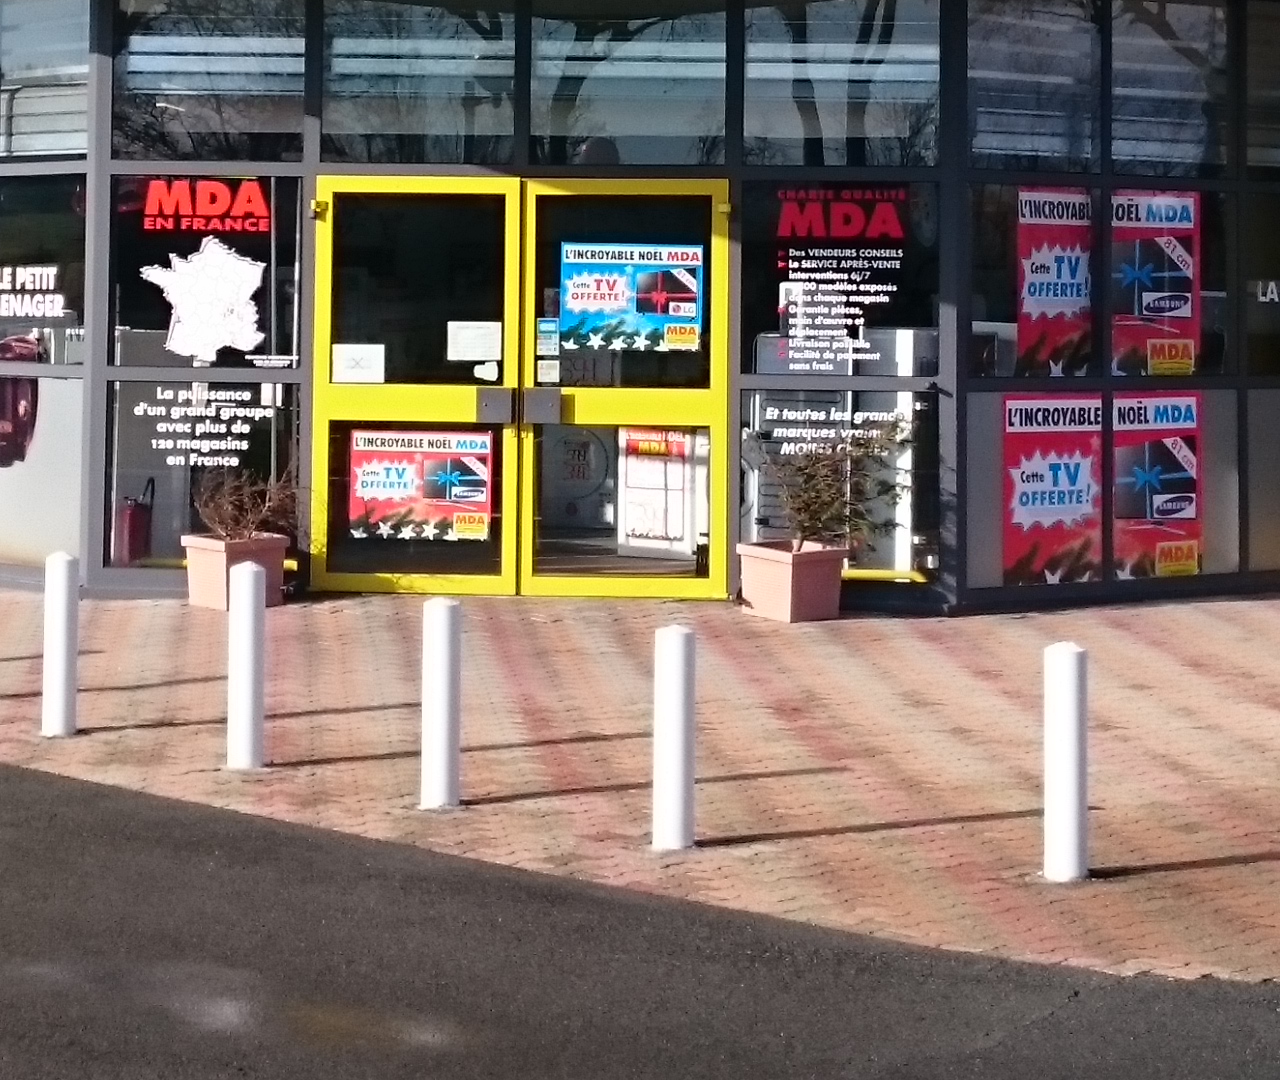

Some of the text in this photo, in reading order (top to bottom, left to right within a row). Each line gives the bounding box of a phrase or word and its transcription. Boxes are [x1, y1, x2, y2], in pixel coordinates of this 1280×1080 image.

[143, 179, 270, 217] MDA
[1112, 198, 1142, 222] OËL
[1145, 203, 1193, 223] MDA
[143, 218, 271, 233] EN FRANCE
[776, 201, 904, 238] MDA
[565, 248, 701, 262] L'INCROYABLE NOËL MDA
[808, 248, 857, 258] VENDEURS
[859, 248, 904, 258] CONSEILS
[800, 259, 838, 269] SERVICE
[839, 257, 901, 269] APRÈS-VENTE
[1030, 255, 1081, 280] Cette TV
[1176, 254, 1191, 270] cm
[15, 266, 58, 290] PETIT
[572, 278, 618, 292] Cette TV
[818, 281, 858, 291] modèles
[858, 282, 898, 294] exposés
[1256, 281, 1280, 302] LA
[813, 292, 848, 304] chaque
[849, 293, 890, 305] magasin
[666, 325, 697, 337] MDA
[788, 338, 831, 348] Livraison
[788, 349, 881, 362] Facilité de paement
[1150, 343, 1193, 361] MDA
[788, 361, 835, 371] sans frais
[156, 386, 174, 400] La
[133, 401, 275, 421] d'un grand groupe
[765, 407, 781, 420] Et
[782, 408, 827, 421] toutes
[830, 407, 851, 421] les
[1007, 400, 1195, 428] L'INCROYABLE NOËL MDA
[156, 419, 251, 436] avec plus de
[773, 427, 836, 441] marques
[176, 436, 250, 453] magasins
[355, 436, 489, 450] L'INCROYABLE NOËL MDA
[166, 453, 240, 467] en France
[361, 467, 407, 480] Cette TV
[1020, 462, 1081, 487] Cette TV
[455, 514, 486, 525] MDA
[1157, 544, 1195, 564] MDA
